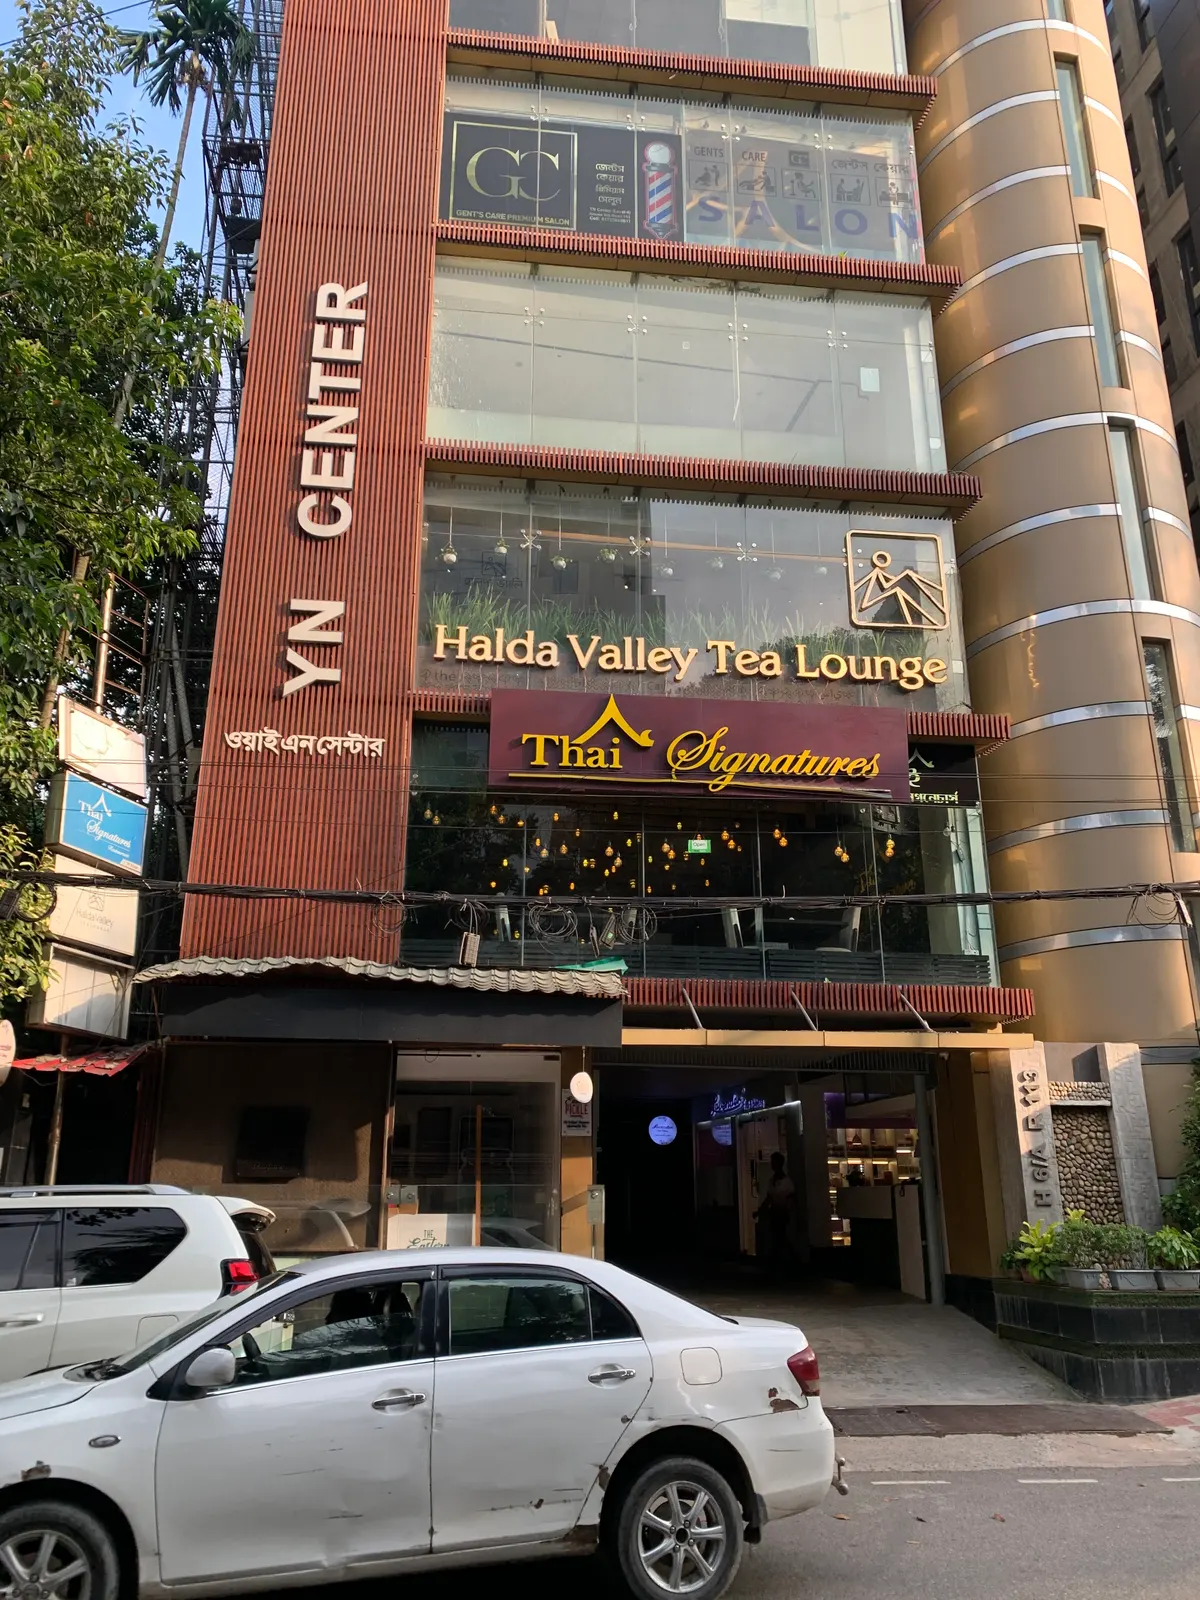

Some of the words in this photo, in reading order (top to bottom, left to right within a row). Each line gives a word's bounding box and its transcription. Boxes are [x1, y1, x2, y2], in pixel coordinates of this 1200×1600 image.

[693, 146, 724, 158] GENTS
[741, 151, 766, 163] CARE
[456, 209, 484, 218] GENT'S
[485, 211, 506, 220] CARE
[507, 213, 544, 223] PREMIUM
[544, 216, 570, 226] SALON
[698, 195, 919, 239] SALON
[296, 281, 369, 540] CENTER
[281, 598, 345, 698] YN
[432, 623, 560, 669] Halda
[567, 634, 698, 682] Valley
[705, 639, 782, 678] Tea
[796, 643, 949, 691] Lounge
[223, 726, 281, 756] ওয়াই
[281, 734, 318, 756] এন
[317, 730, 386, 758] সেন্টার
[520, 731, 624, 771] Thai
[665, 725, 882, 793] Signatures
[78, 799, 104, 822] Thai
[86, 819, 132, 848] Signatures
[1026, 1110, 1044, 1131] R
[1034, 1189, 1052, 1208] H
[423, 1229, 434, 1238] THE
